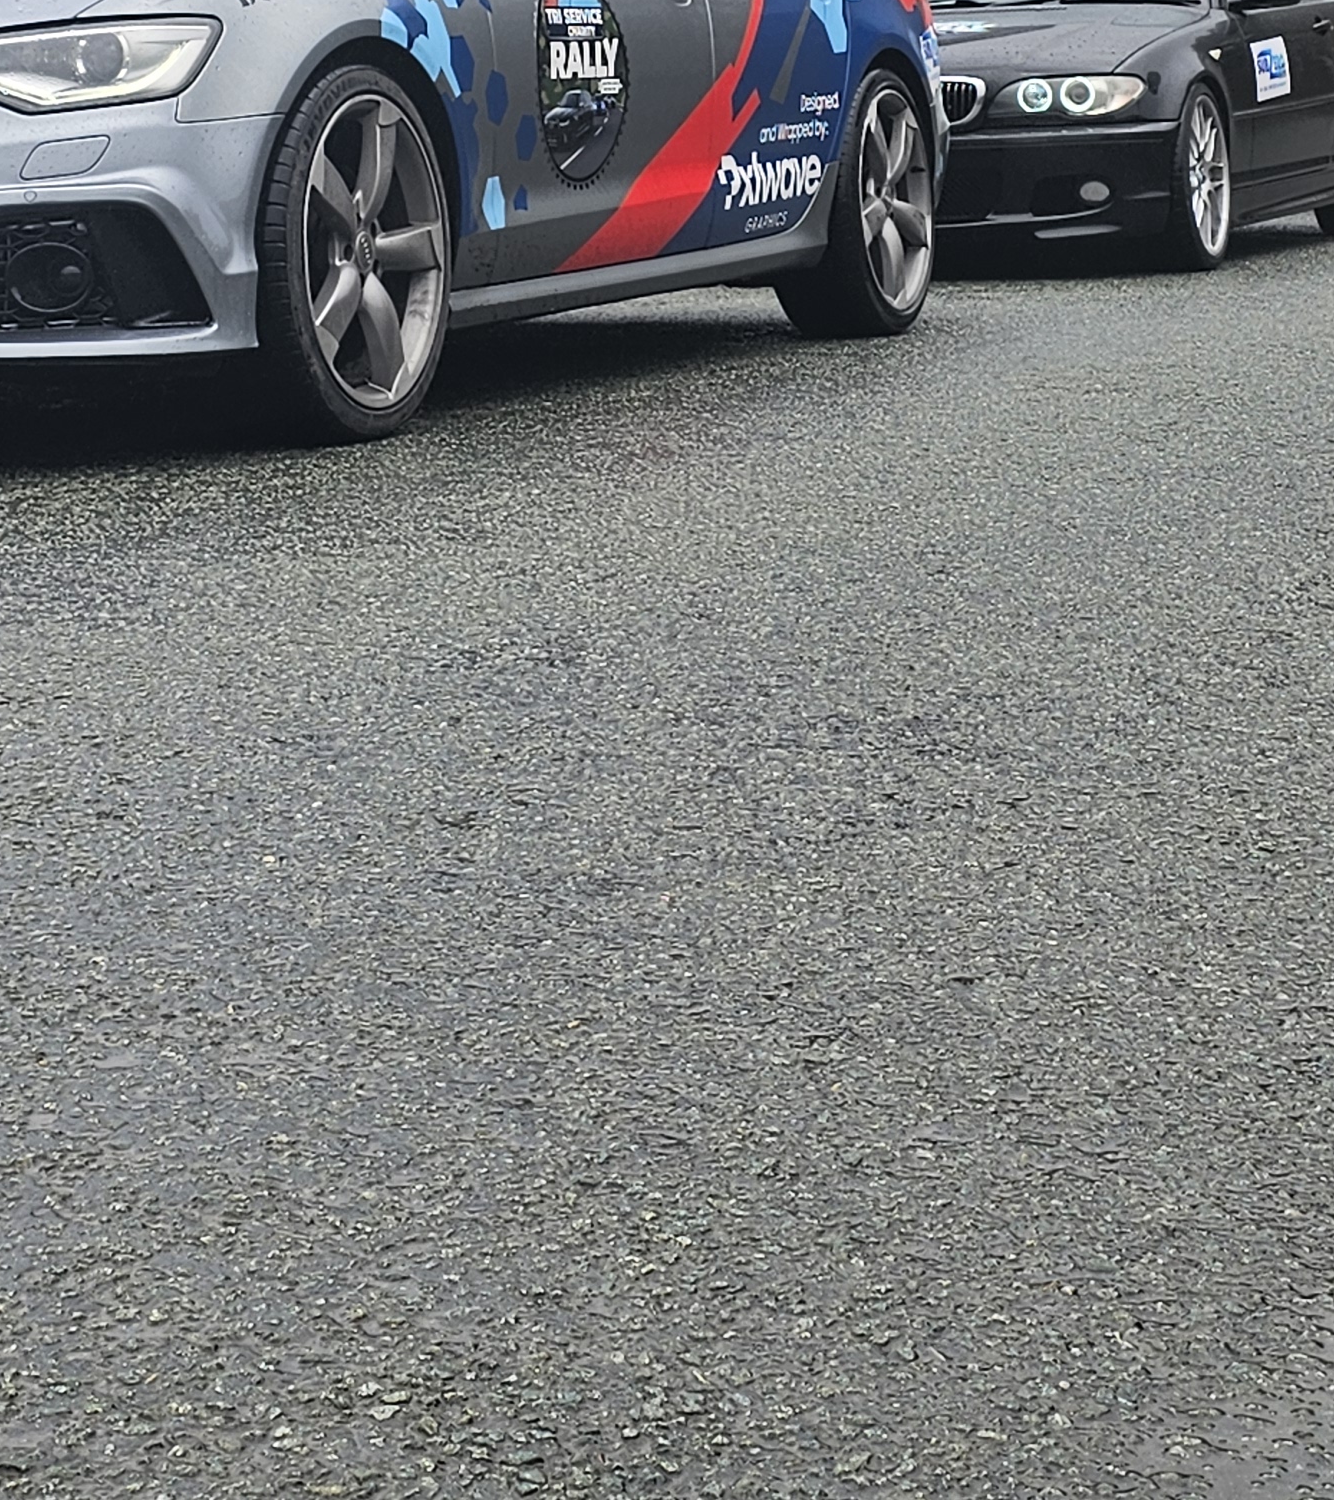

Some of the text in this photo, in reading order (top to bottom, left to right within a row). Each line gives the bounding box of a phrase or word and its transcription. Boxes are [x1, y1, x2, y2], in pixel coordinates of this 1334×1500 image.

[545, 8, 603, 24] TRI SERVICE
[567, 26, 596, 37] CHARITY
[550, 37, 619, 79] RALLY
[800, 91, 839, 115] Designed
[759, 124, 778, 143] and
[776, 119, 814, 144] Wrapped
[745, 211, 788, 233] GRAPHICS
